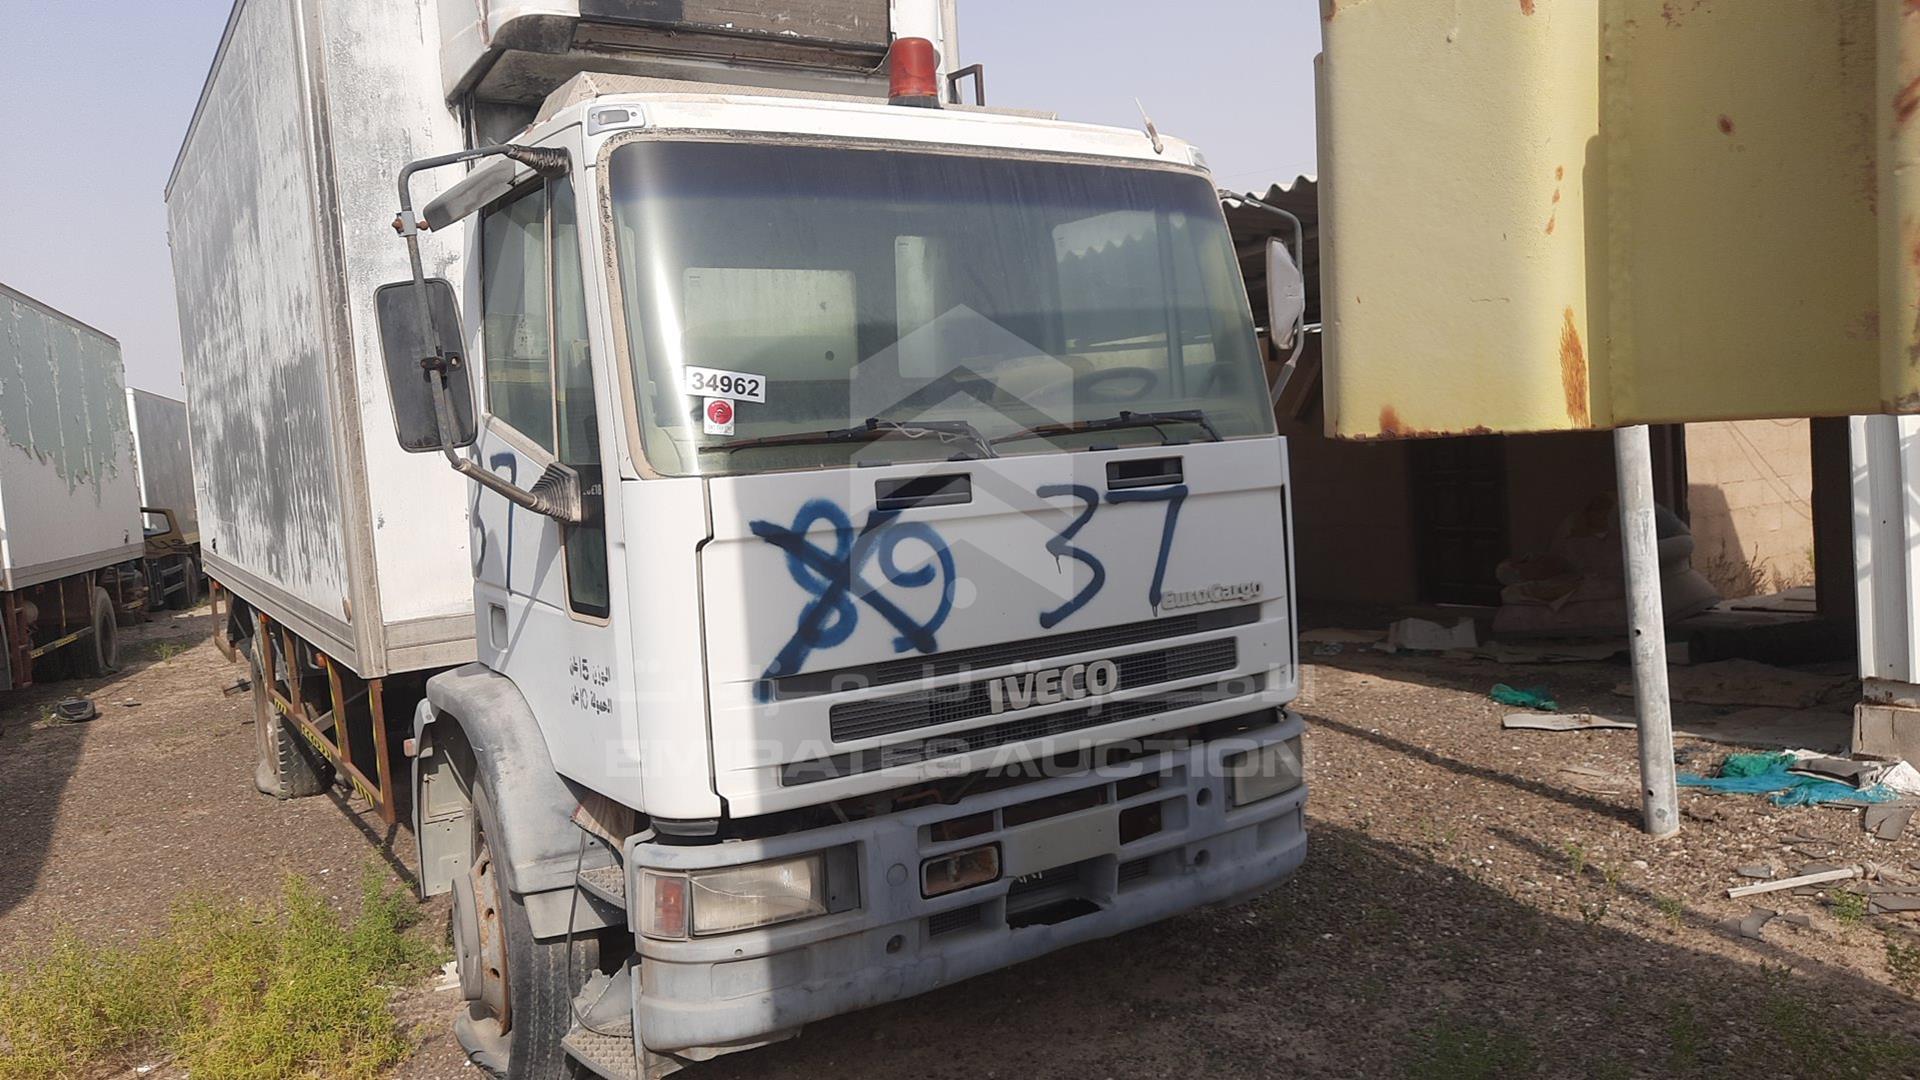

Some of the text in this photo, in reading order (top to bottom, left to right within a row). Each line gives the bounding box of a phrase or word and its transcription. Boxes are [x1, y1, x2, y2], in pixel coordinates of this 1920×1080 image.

[692, 372, 760, 398] 34962
[1036, 484, 1188, 629] 37
[1161, 582, 1262, 610] EuroCargo
[989, 659, 1118, 715] IVECO
